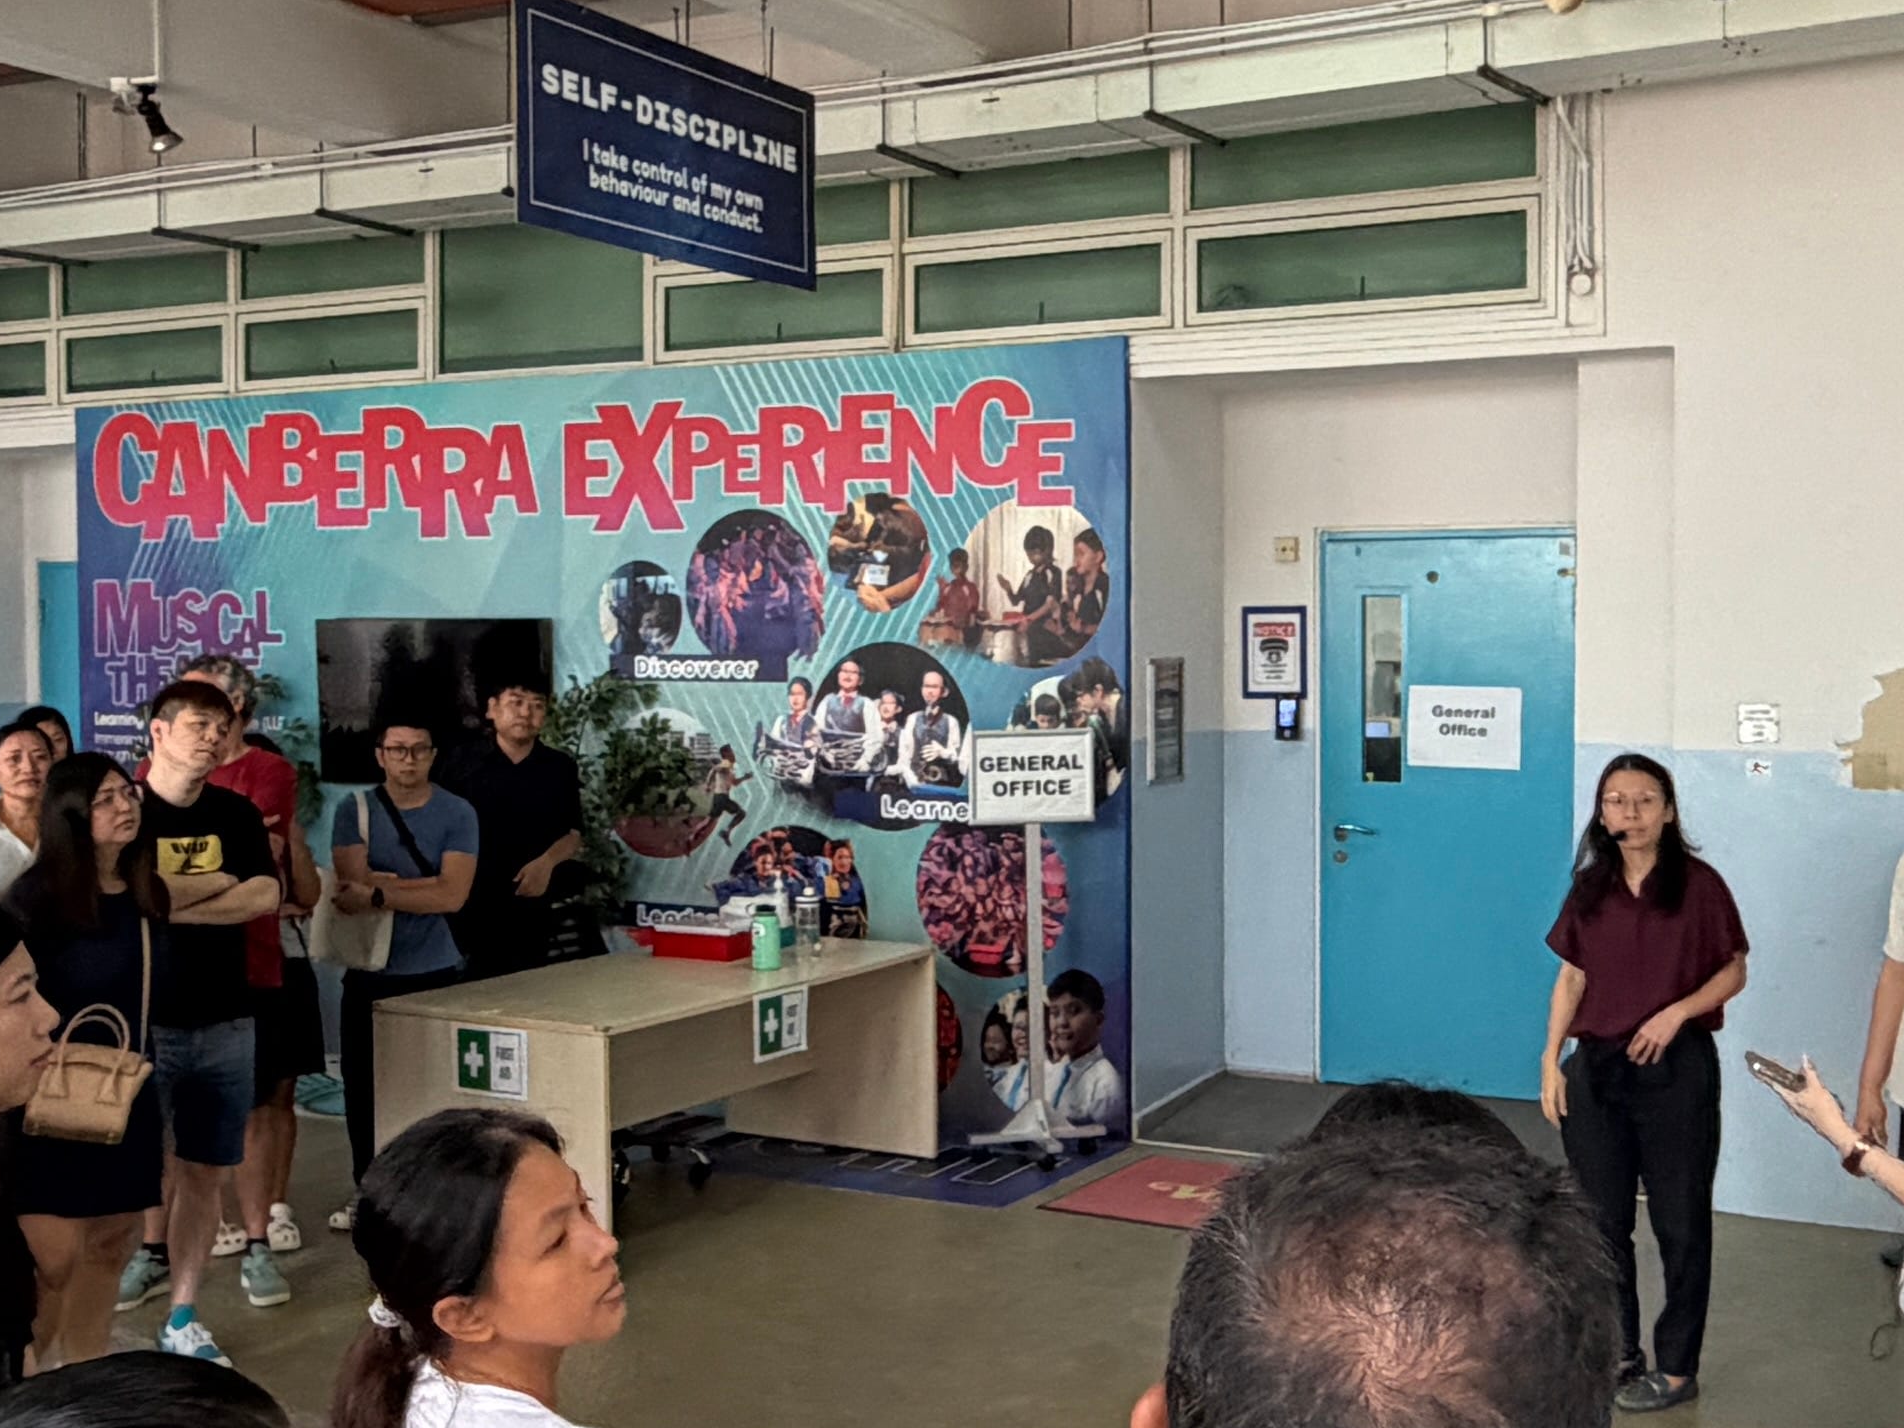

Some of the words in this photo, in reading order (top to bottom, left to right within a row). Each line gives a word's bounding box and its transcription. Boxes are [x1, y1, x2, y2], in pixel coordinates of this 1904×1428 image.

[541, 63, 798, 173] SELF-DISCIPLINE
[583, 139, 589, 162] I
[592, 142, 629, 173] take
[632, 159, 688, 190] control
[691, 173, 709, 194] of
[710, 181, 732, 203] my
[735, 191, 764, 210] own
[589, 167, 671, 208] behaviour
[672, 191, 701, 217] and
[703, 203, 764, 234] conduct.
[93, 406, 539, 540] CANBERRA
[562, 377, 1076, 533] EXPERIENCE
[634, 655, 759, 680] Discoverer
[1432, 705, 1496, 719] General
[1439, 723, 1488, 737] Office
[979, 754, 1084, 773] GENERAL
[992, 779, 1072, 798] OFFICE
[880, 794, 970, 822] Learne
